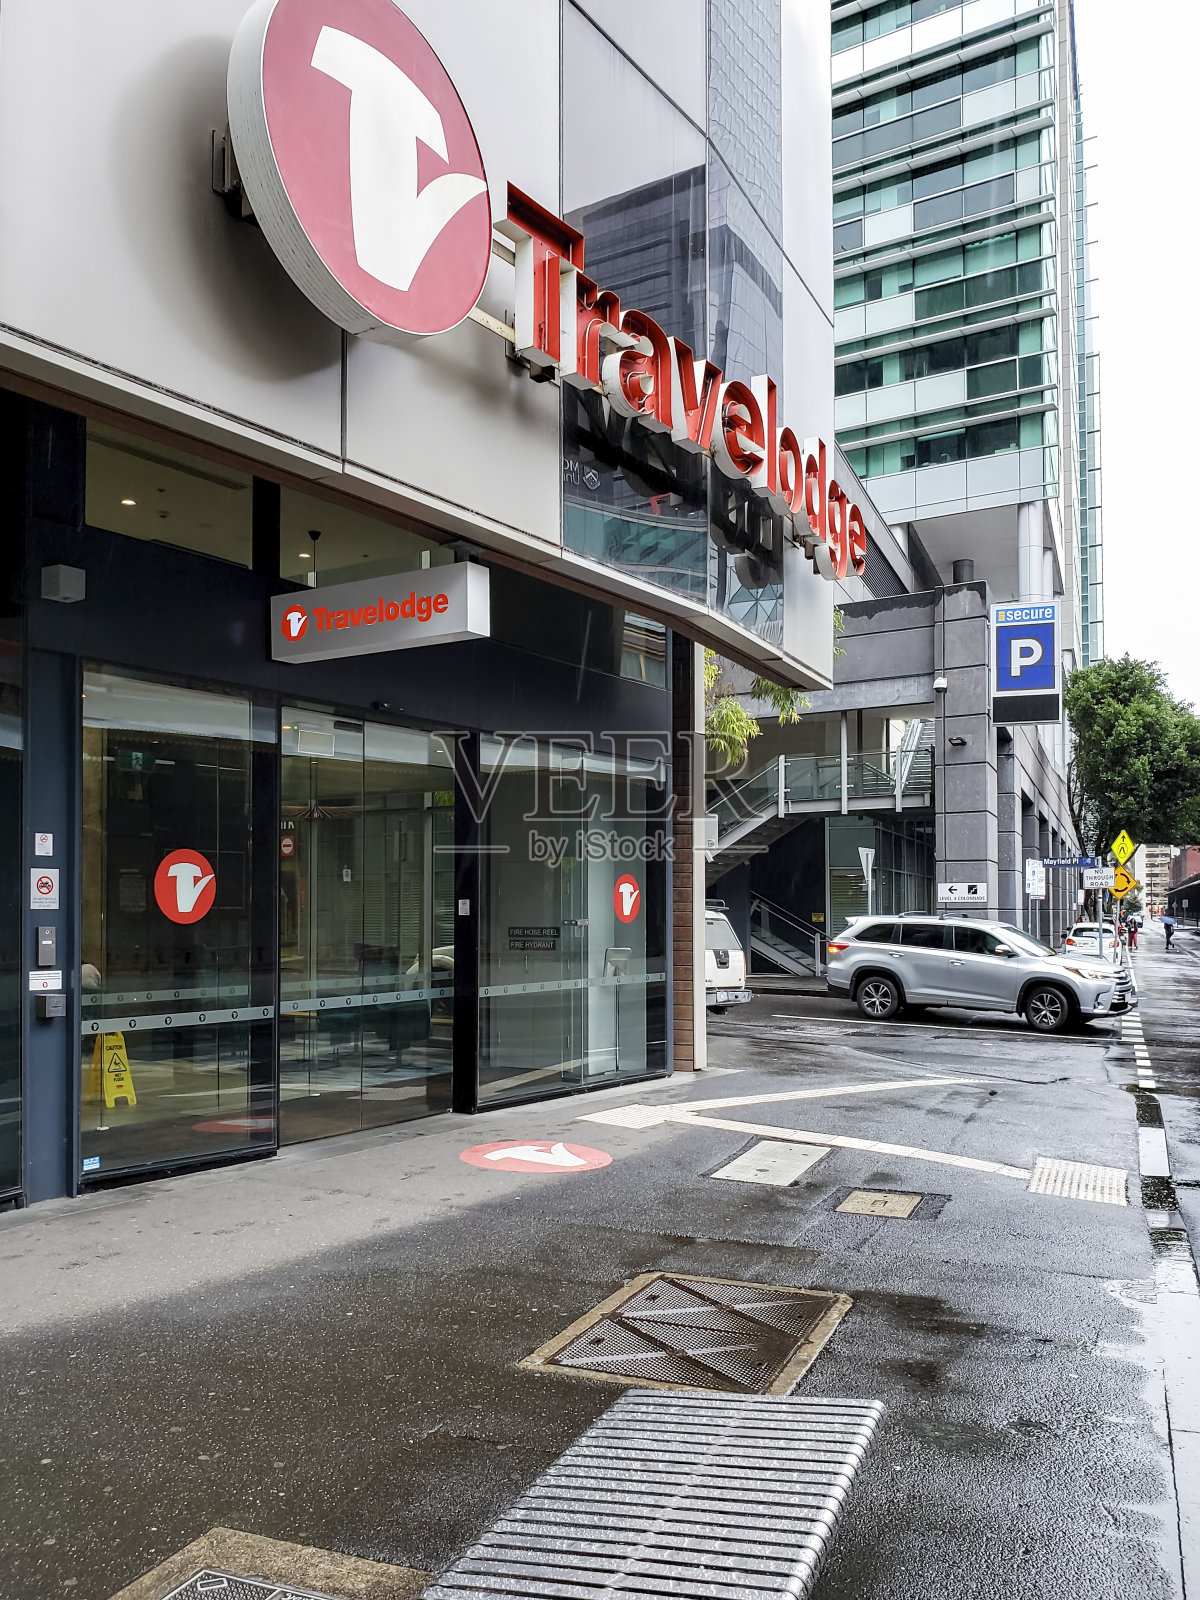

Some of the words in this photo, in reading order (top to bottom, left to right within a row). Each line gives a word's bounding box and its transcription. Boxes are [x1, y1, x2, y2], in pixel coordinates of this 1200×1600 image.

[493, 180, 867, 581] Travelodge
[312, 591, 449, 632] Travelodge
[1006, 607, 1053, 621] secure
[1010, 637, 1043, 678] P
[1043, 857, 1071, 866] Mayfield
[510, 928, 524, 936] FIRE
[525, 941, 554, 949] HYDRANT
